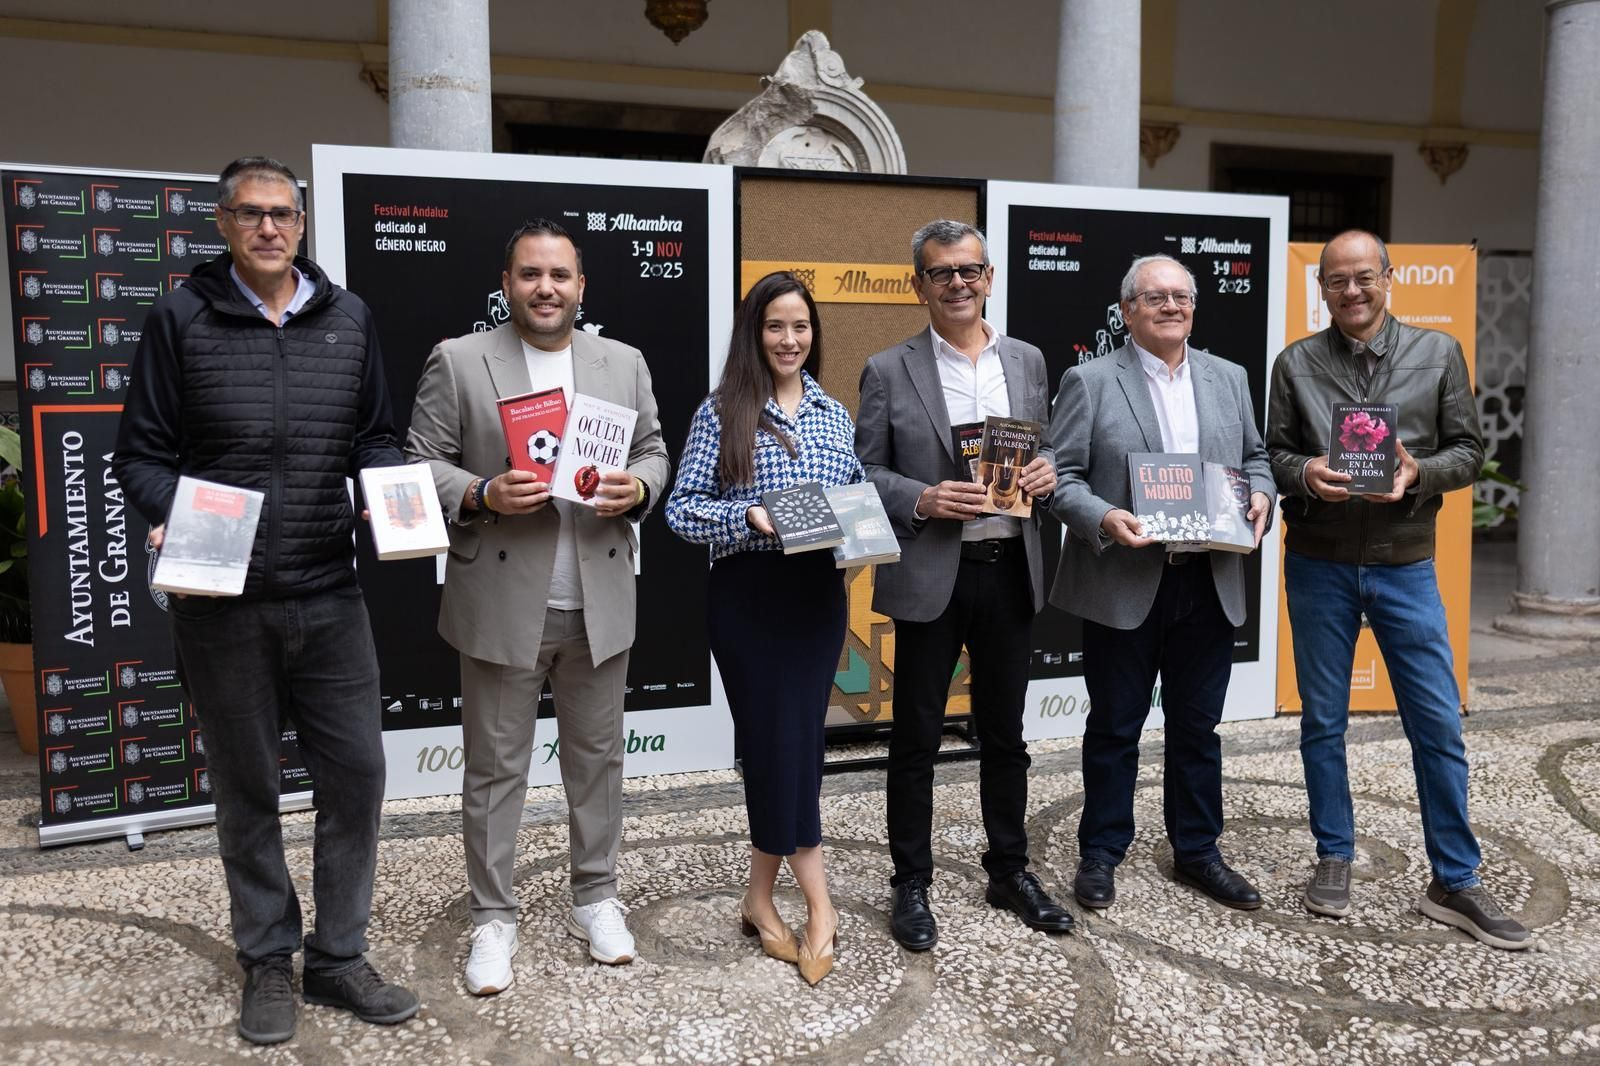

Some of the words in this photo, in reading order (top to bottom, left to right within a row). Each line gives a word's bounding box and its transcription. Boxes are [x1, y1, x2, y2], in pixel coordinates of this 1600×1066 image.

[38, 193, 80, 201] AYUNTAMIENTO
[114, 196, 154, 205] AYUNTAMIENTO
[126, 203, 151, 211] GRANADA
[374, 204, 410, 217] Festival
[412, 205, 448, 218] Andaluz
[375, 221, 416, 233] dedicado
[418, 222, 426, 234] al
[609, 213, 683, 232] Alhambra
[1029, 231, 1055, 241] Festival
[1057, 232, 1083, 242] Andaluz
[116, 241, 156, 249] AYUNTAMIENTO
[375, 237, 412, 252] GÉNERO
[415, 239, 446, 252] NEGRO
[632, 241, 654, 257] 3-9
[657, 242, 683, 257] NOV
[1029, 245, 1058, 256] dedicado
[1060, 247, 1066, 256] al
[1197, 237, 1251, 254] Alhambra
[640, 261, 684, 278] 2025
[1029, 259, 1056, 271] GÉNERO
[1057, 261, 1080, 272] NEGRO
[1213, 261, 1230, 275] 3-9
[1231, 263, 1251, 275] NOV
[118, 285, 158, 293] AYUNTAMIENTO
[833, 270, 912, 295] Alhamb
[1219, 279, 1251, 294] 2025
[511, 406, 534, 415] Bacalao
[578, 415, 625, 445] OCULTA
[1000, 431, 1027, 440] CRIMEN
[572, 437, 622, 467] NOCHE
[1002, 441, 1031, 450] ALBERCA
[1339, 453, 1385, 461] ASESINATO
[1139, 467, 1156, 482] EL
[1159, 467, 1194, 483] OTRO
[1144, 484, 1192, 500] MUNDO
[62, 431, 95, 647] AYUNTAMIENTO
[111, 591, 130, 627] DE
[64, 676, 105, 686] AYUNTAMIENTO
[140, 708, 179, 718] AYUNTAMIENTO
[1040, 695, 1076, 719] 100
[67, 715, 108, 726] AYUNTAMIENTO
[142, 745, 181, 755] AYUNTAMIENTO
[69, 752, 109, 763] AYUNTAMIENTO
[416, 745, 465, 774] 100
[146, 784, 184, 792] AYUNTAMIENTO
[73, 793, 114, 803] AYUNTAMIENTO
